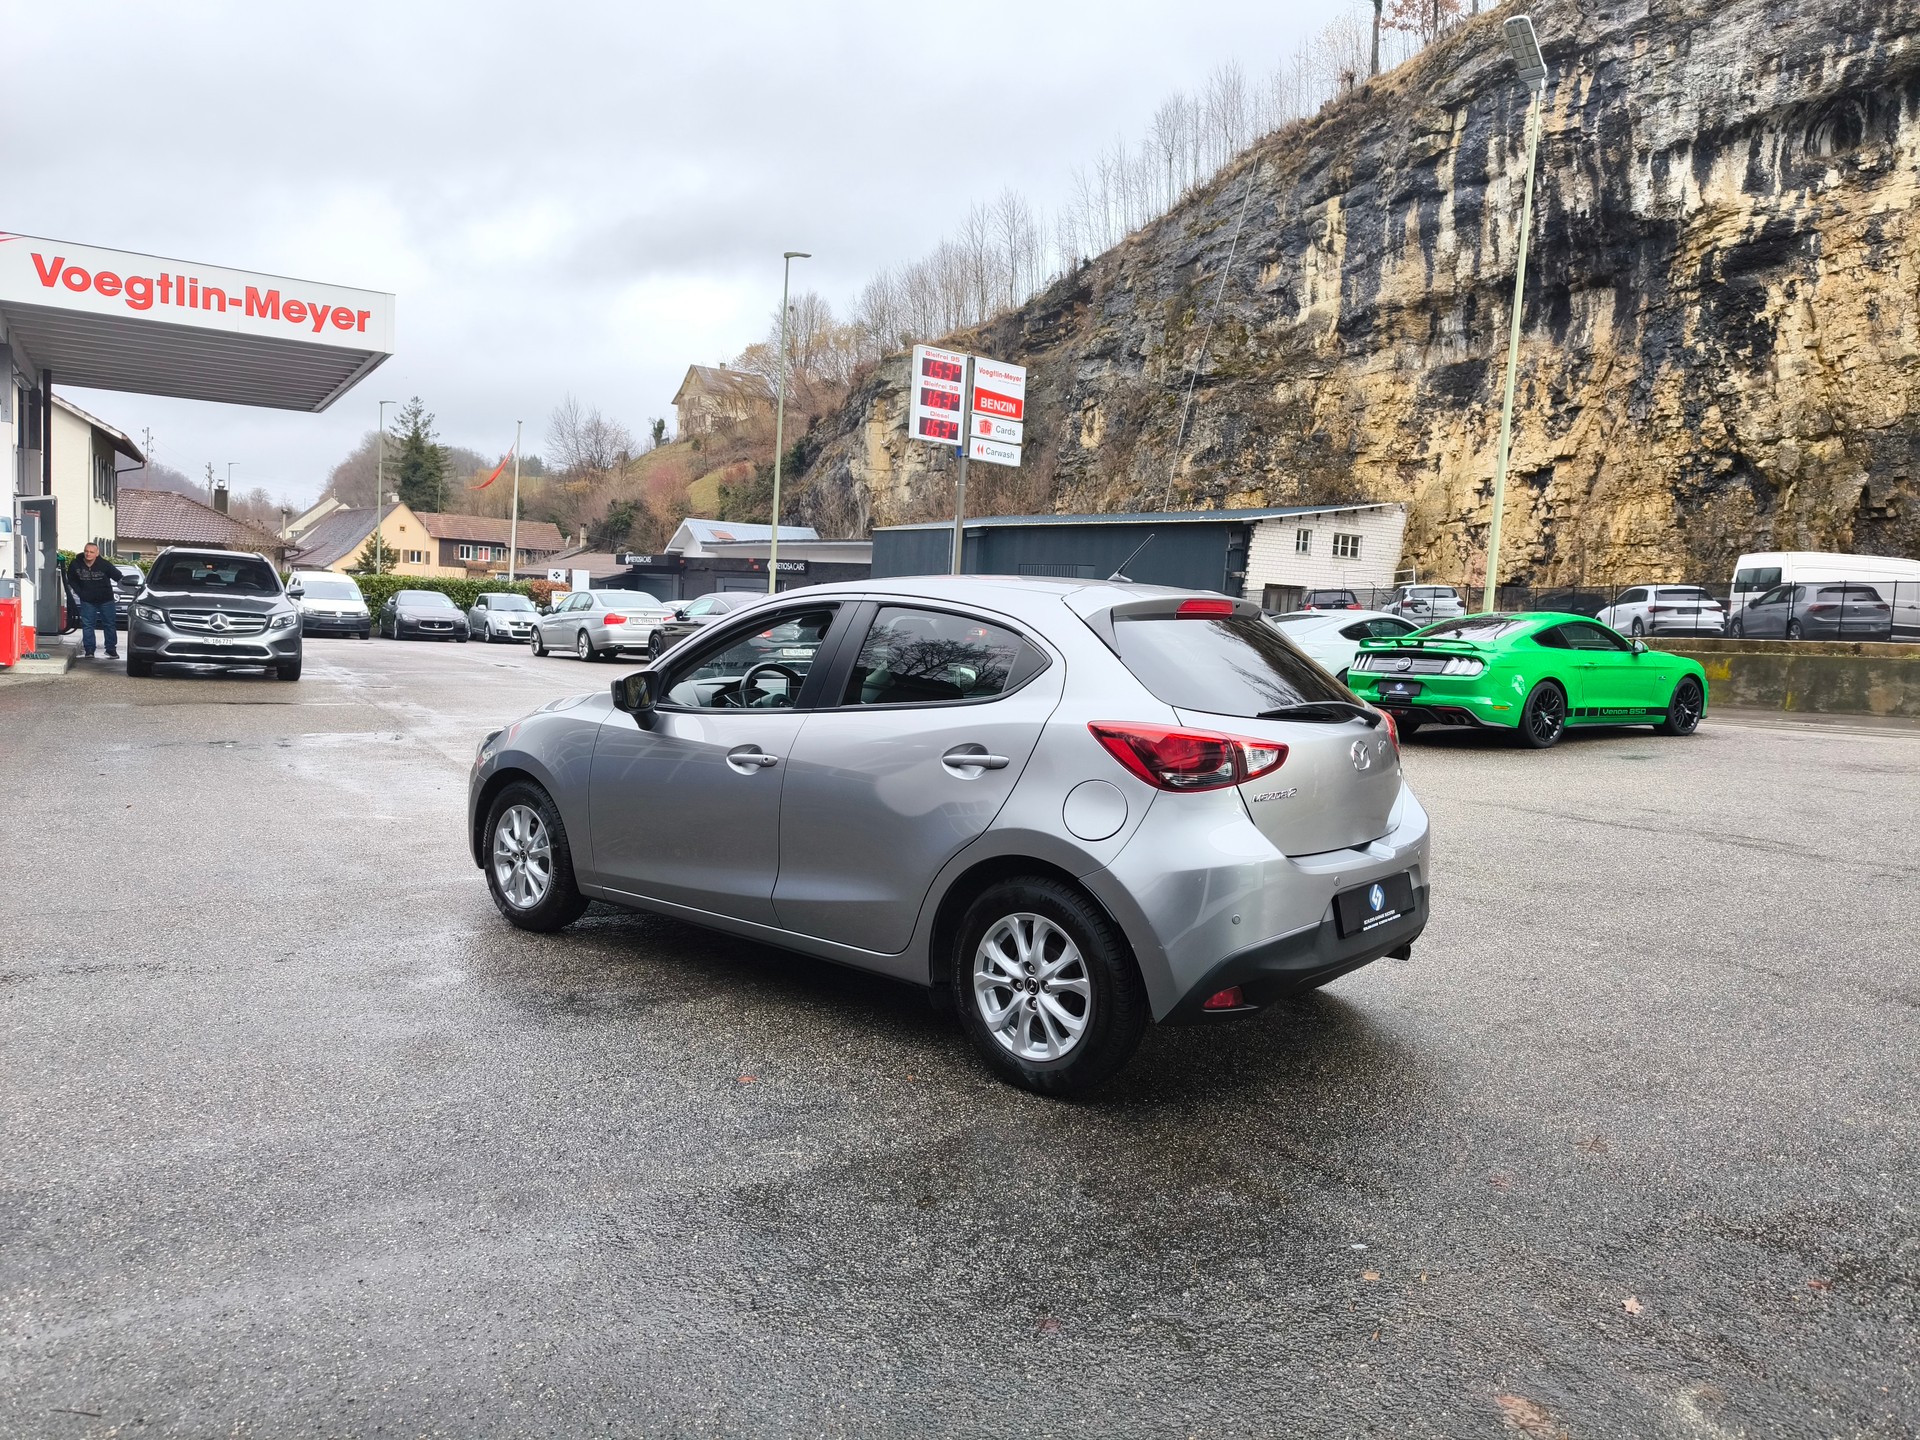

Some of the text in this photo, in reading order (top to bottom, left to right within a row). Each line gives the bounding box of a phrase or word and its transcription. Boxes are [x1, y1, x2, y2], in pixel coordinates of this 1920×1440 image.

[31, 253, 370, 333] Voegtlin-Meyer
[925, 350, 960, 363] Bleifrei 95
[978, 366, 1022, 383] Voegtlin-Meyer
[923, 380, 947, 390] Bleifrei
[980, 397, 1016, 414] BENZIN
[929, 410, 950, 419] Diesel
[995, 425, 1016, 436] Cards
[985, 447, 1015, 459] Carwash
[793, 562, 805, 571] CARS
